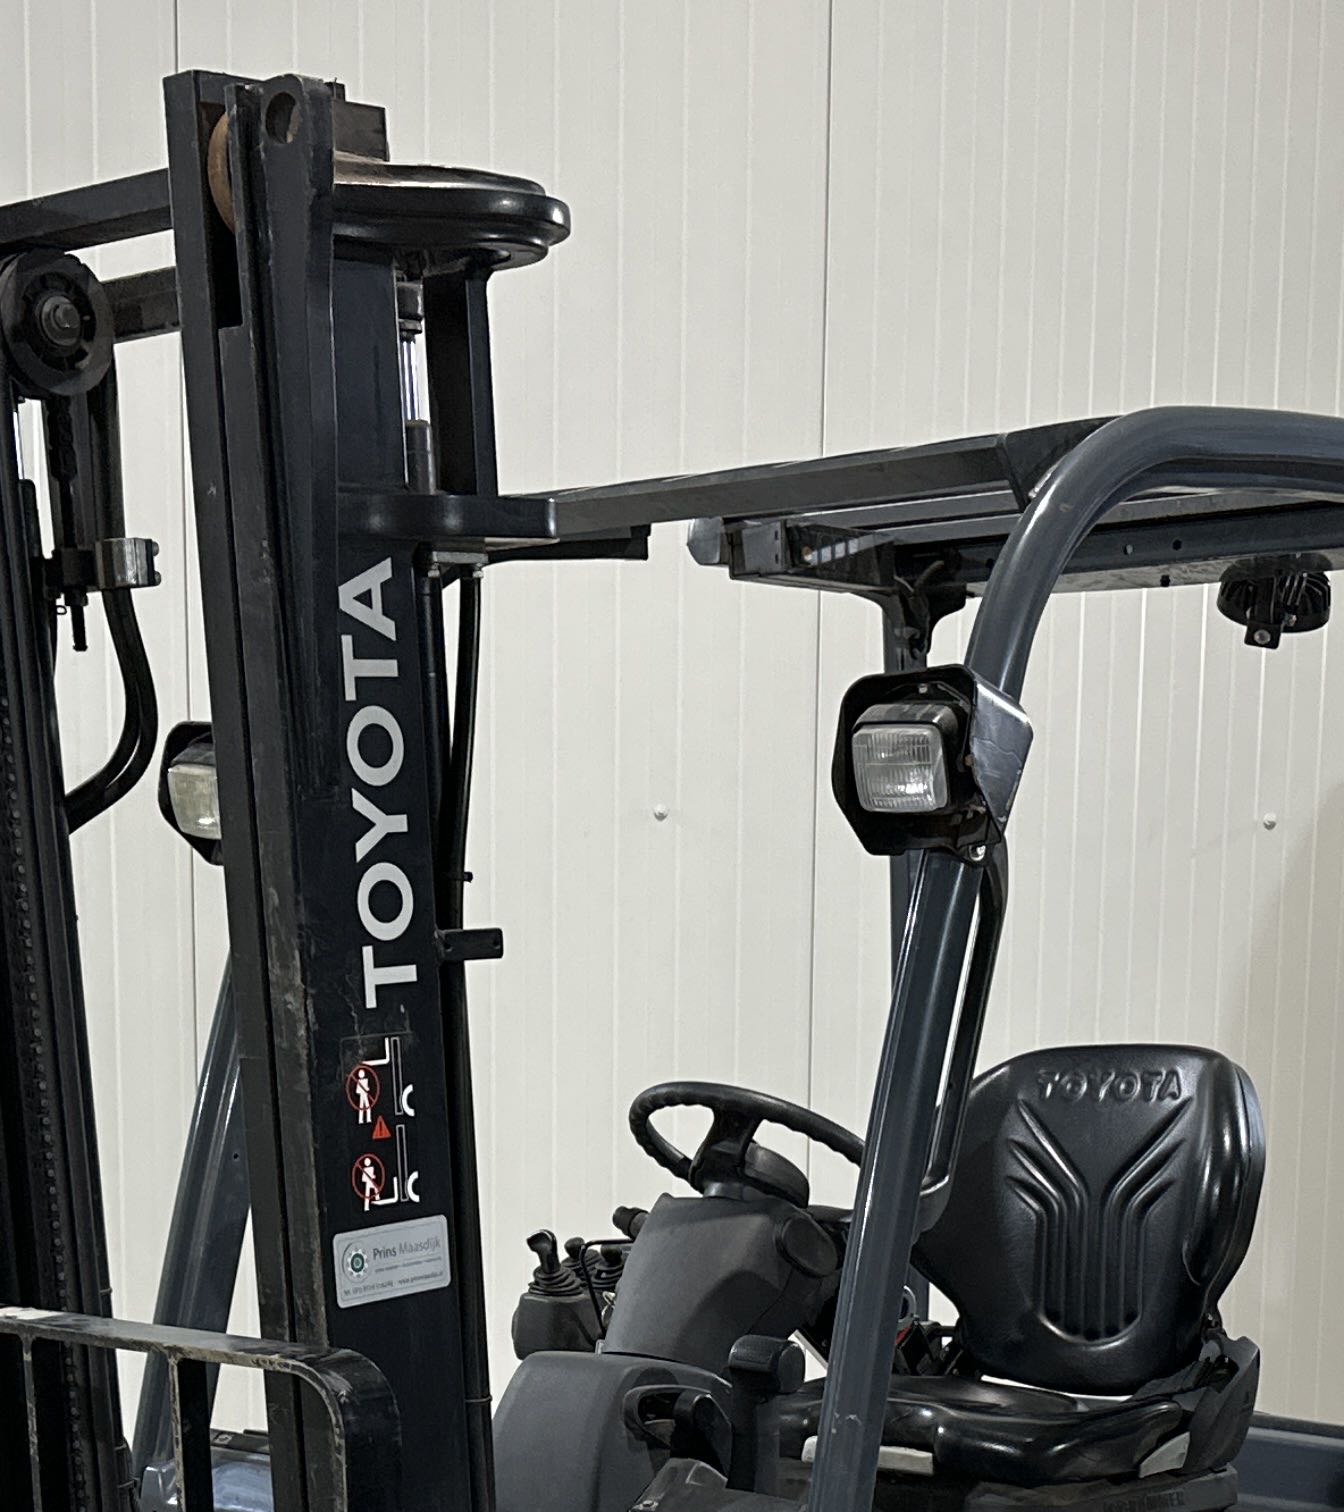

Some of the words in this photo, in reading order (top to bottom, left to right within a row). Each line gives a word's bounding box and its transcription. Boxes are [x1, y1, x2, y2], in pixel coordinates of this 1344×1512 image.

[338, 557, 418, 1009] TOYOTA
[1037, 1068, 1183, 1102] TOYOTA
[372, 1245, 397, 1261] Prins
